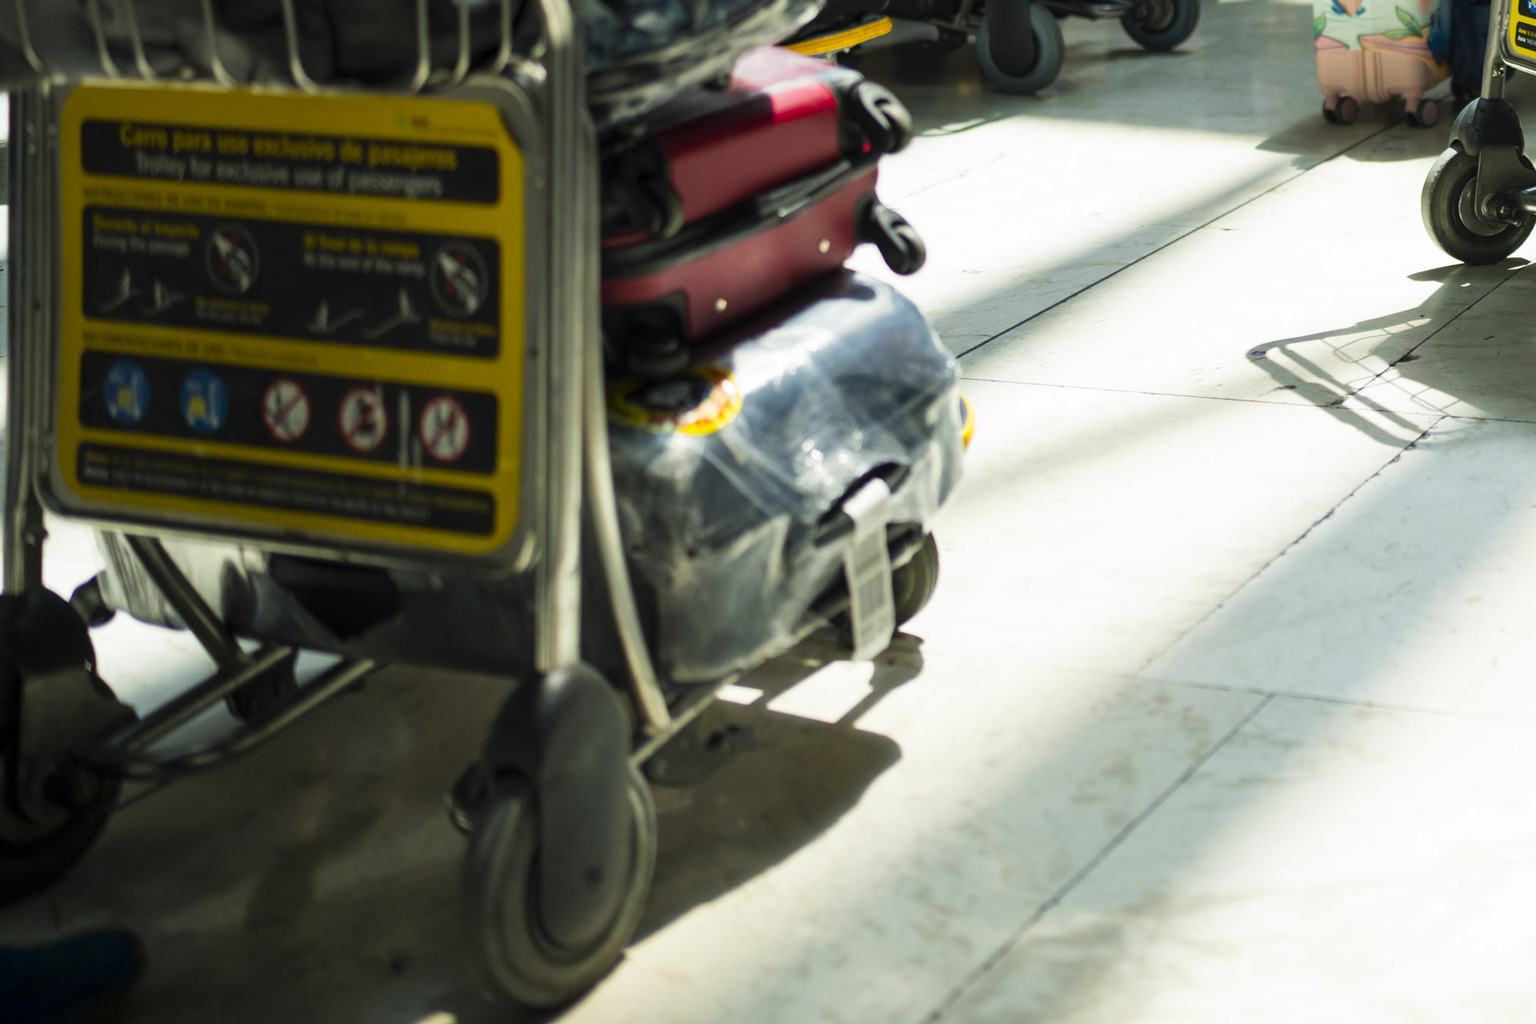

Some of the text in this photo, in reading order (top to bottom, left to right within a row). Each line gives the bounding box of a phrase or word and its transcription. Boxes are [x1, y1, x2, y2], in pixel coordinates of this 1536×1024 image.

[121, 124, 458, 175] Carro para uso exclusivo de pasajeros
[136, 152, 443, 202] Trolley for exclusive use of passengers
